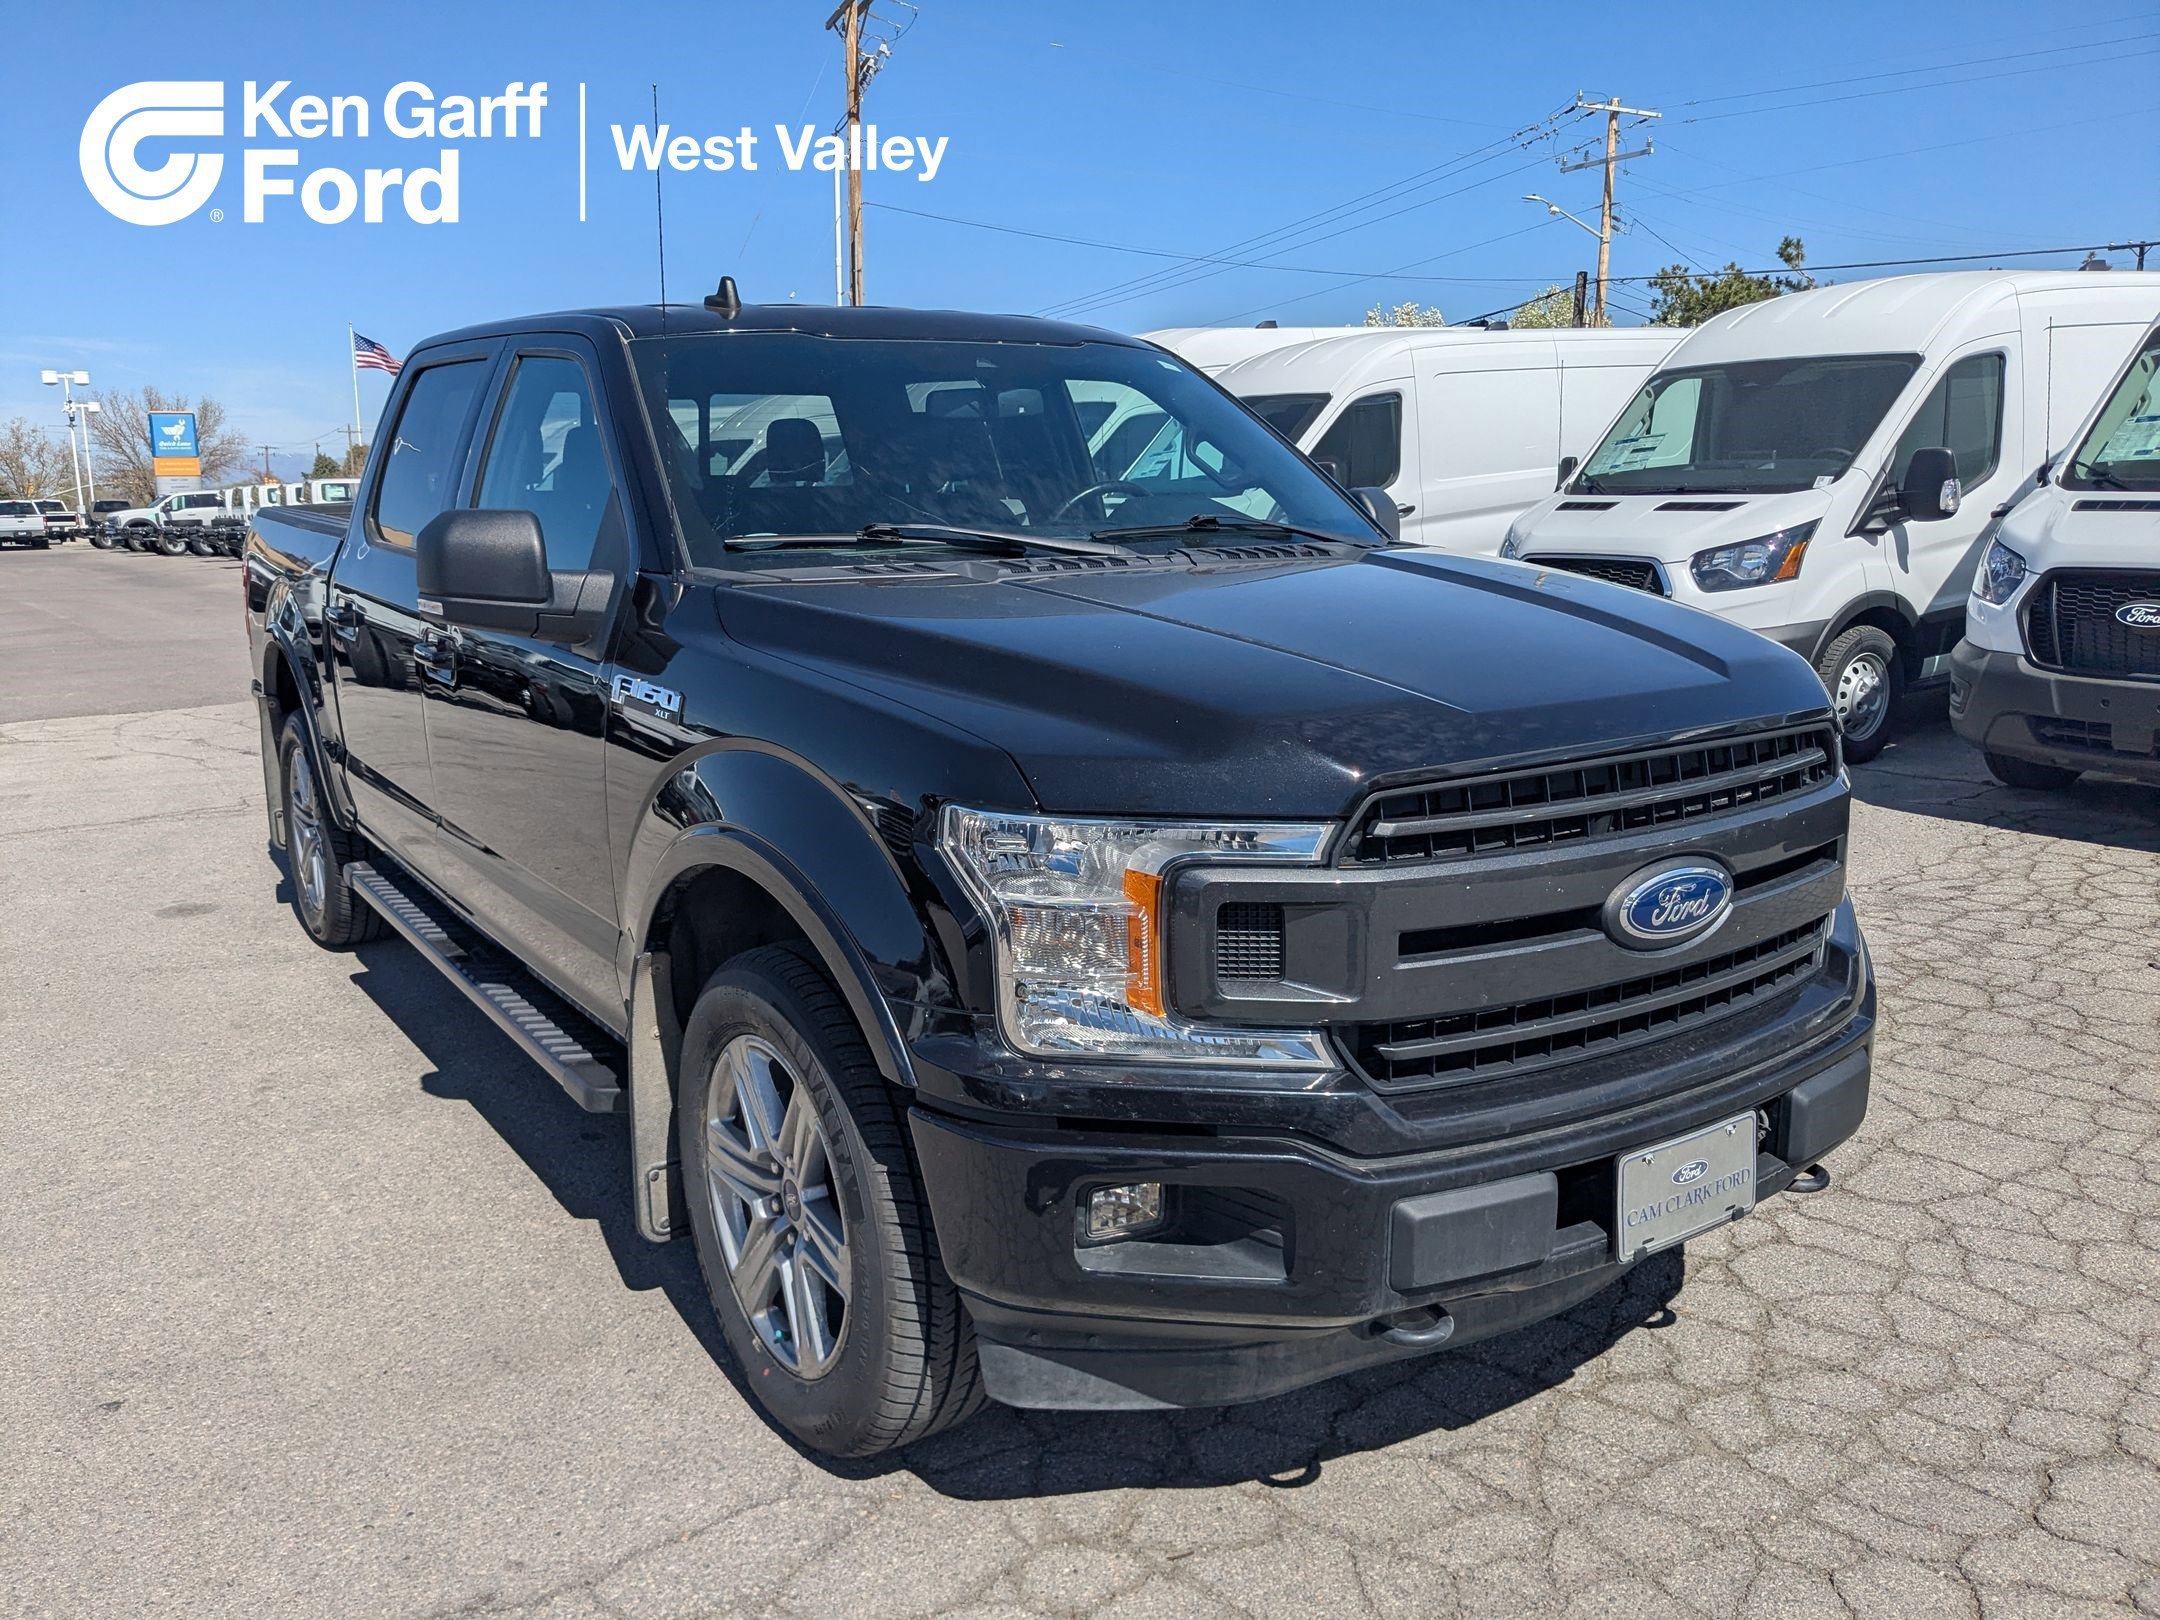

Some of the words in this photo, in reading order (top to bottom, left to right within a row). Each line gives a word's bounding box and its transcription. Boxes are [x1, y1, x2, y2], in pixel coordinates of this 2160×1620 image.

[655, 709, 670, 720] XLT
[1651, 882, 1711, 926] Ford
[1678, 1163, 1701, 1182] Ford
[1626, 1202, 1662, 1228] CAM
[1665, 1183, 1713, 1206] CLARK
[1715, 1168, 1751, 1195] FORD
